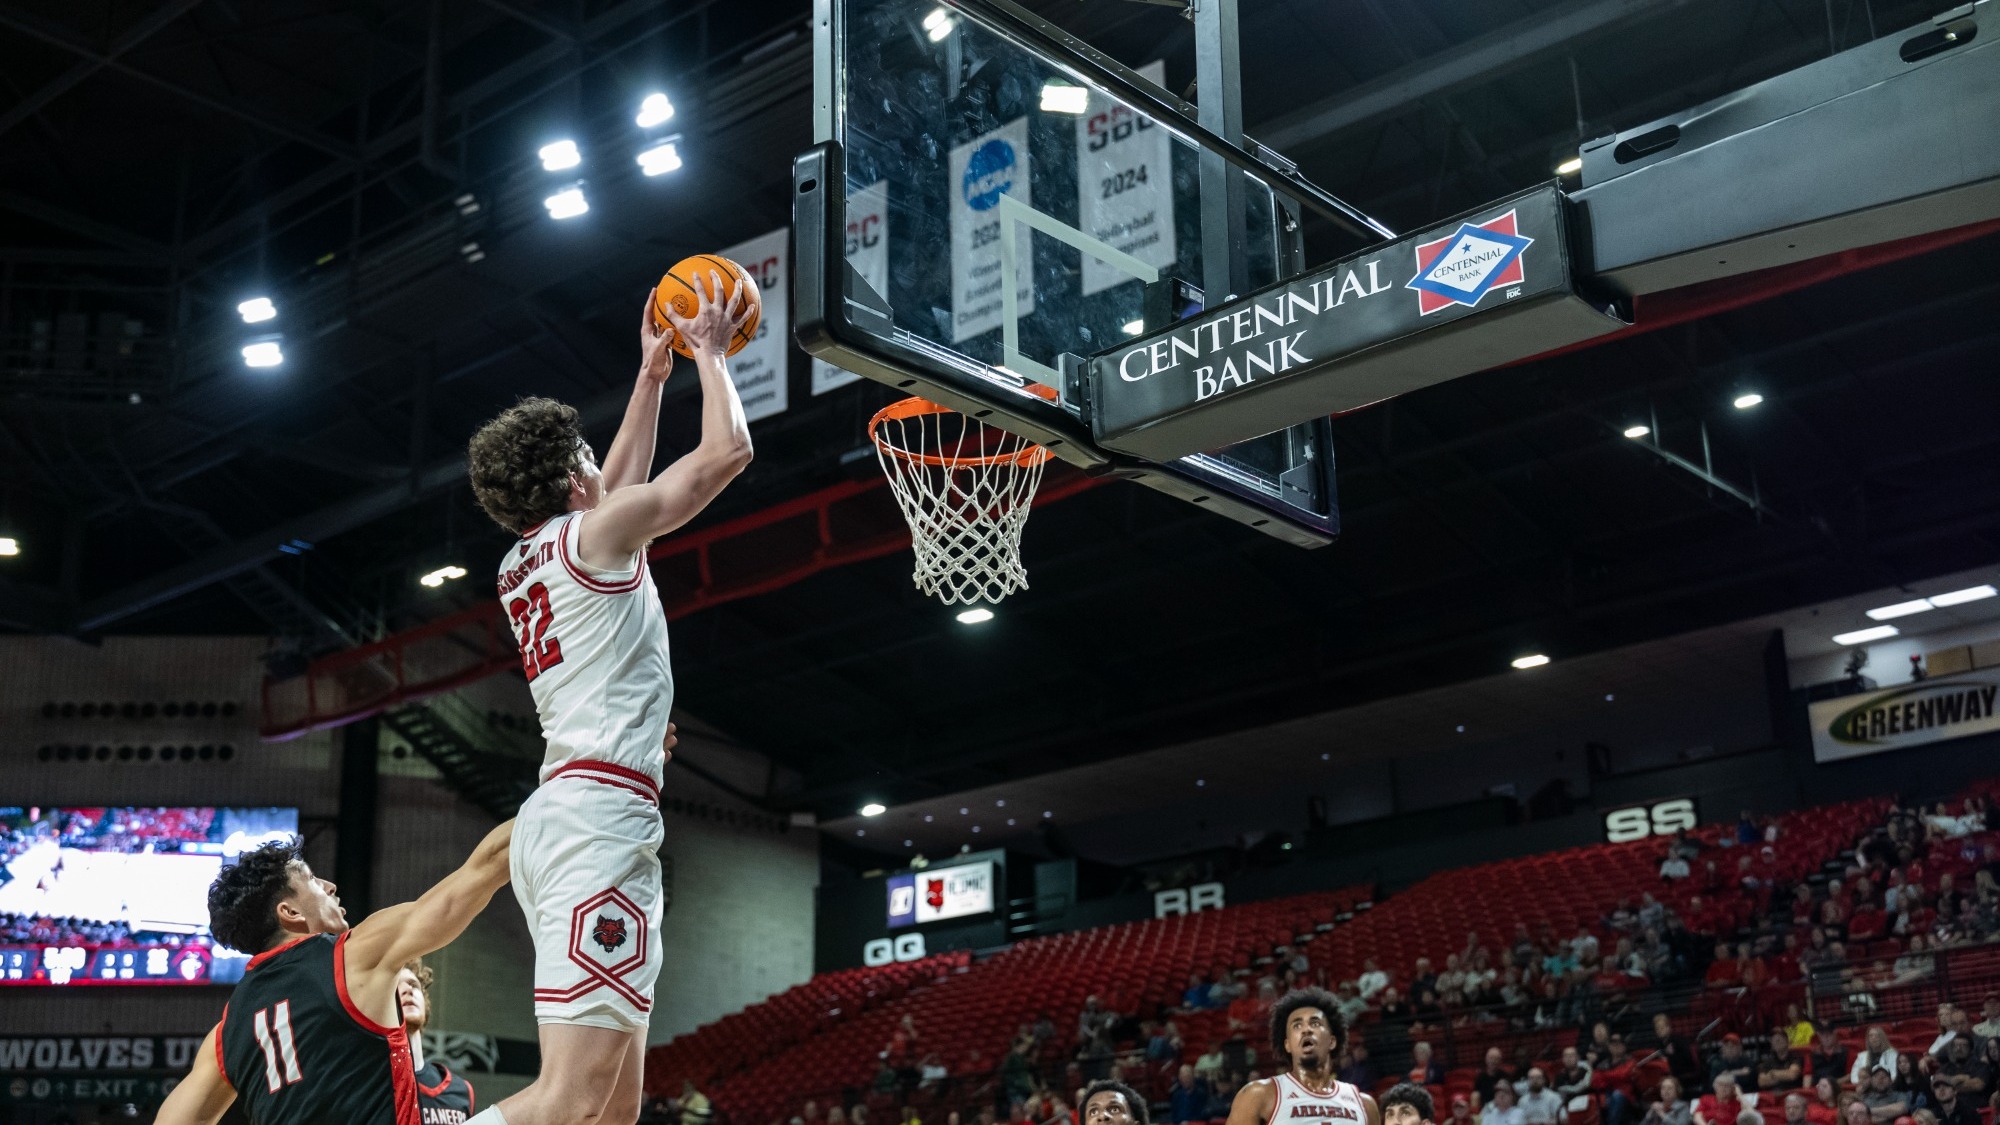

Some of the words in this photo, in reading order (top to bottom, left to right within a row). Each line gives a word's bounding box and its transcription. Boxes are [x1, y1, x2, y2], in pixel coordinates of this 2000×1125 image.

[1101, 163, 1148, 199] 2024
[1433, 247, 1503, 279] CENTENNIAL
[1459, 268, 1482, 282] BANK
[1506, 288, 1521, 300] FDIC
[1119, 260, 1392, 383] CENTENNIAL
[1193, 330, 1313, 402] BANK
[510, 582, 564, 683] 22
[1851, 685, 1997, 741] GREENWAY
[1606, 799, 1697, 843] SS
[1154, 882, 1225, 919] RR
[0, 1037, 154, 1069] WOLVES
[254, 999, 303, 1095] 11
[75, 1079, 138, 1097] EXIT
[1290, 1105, 1358, 1122] ARKANSAS
